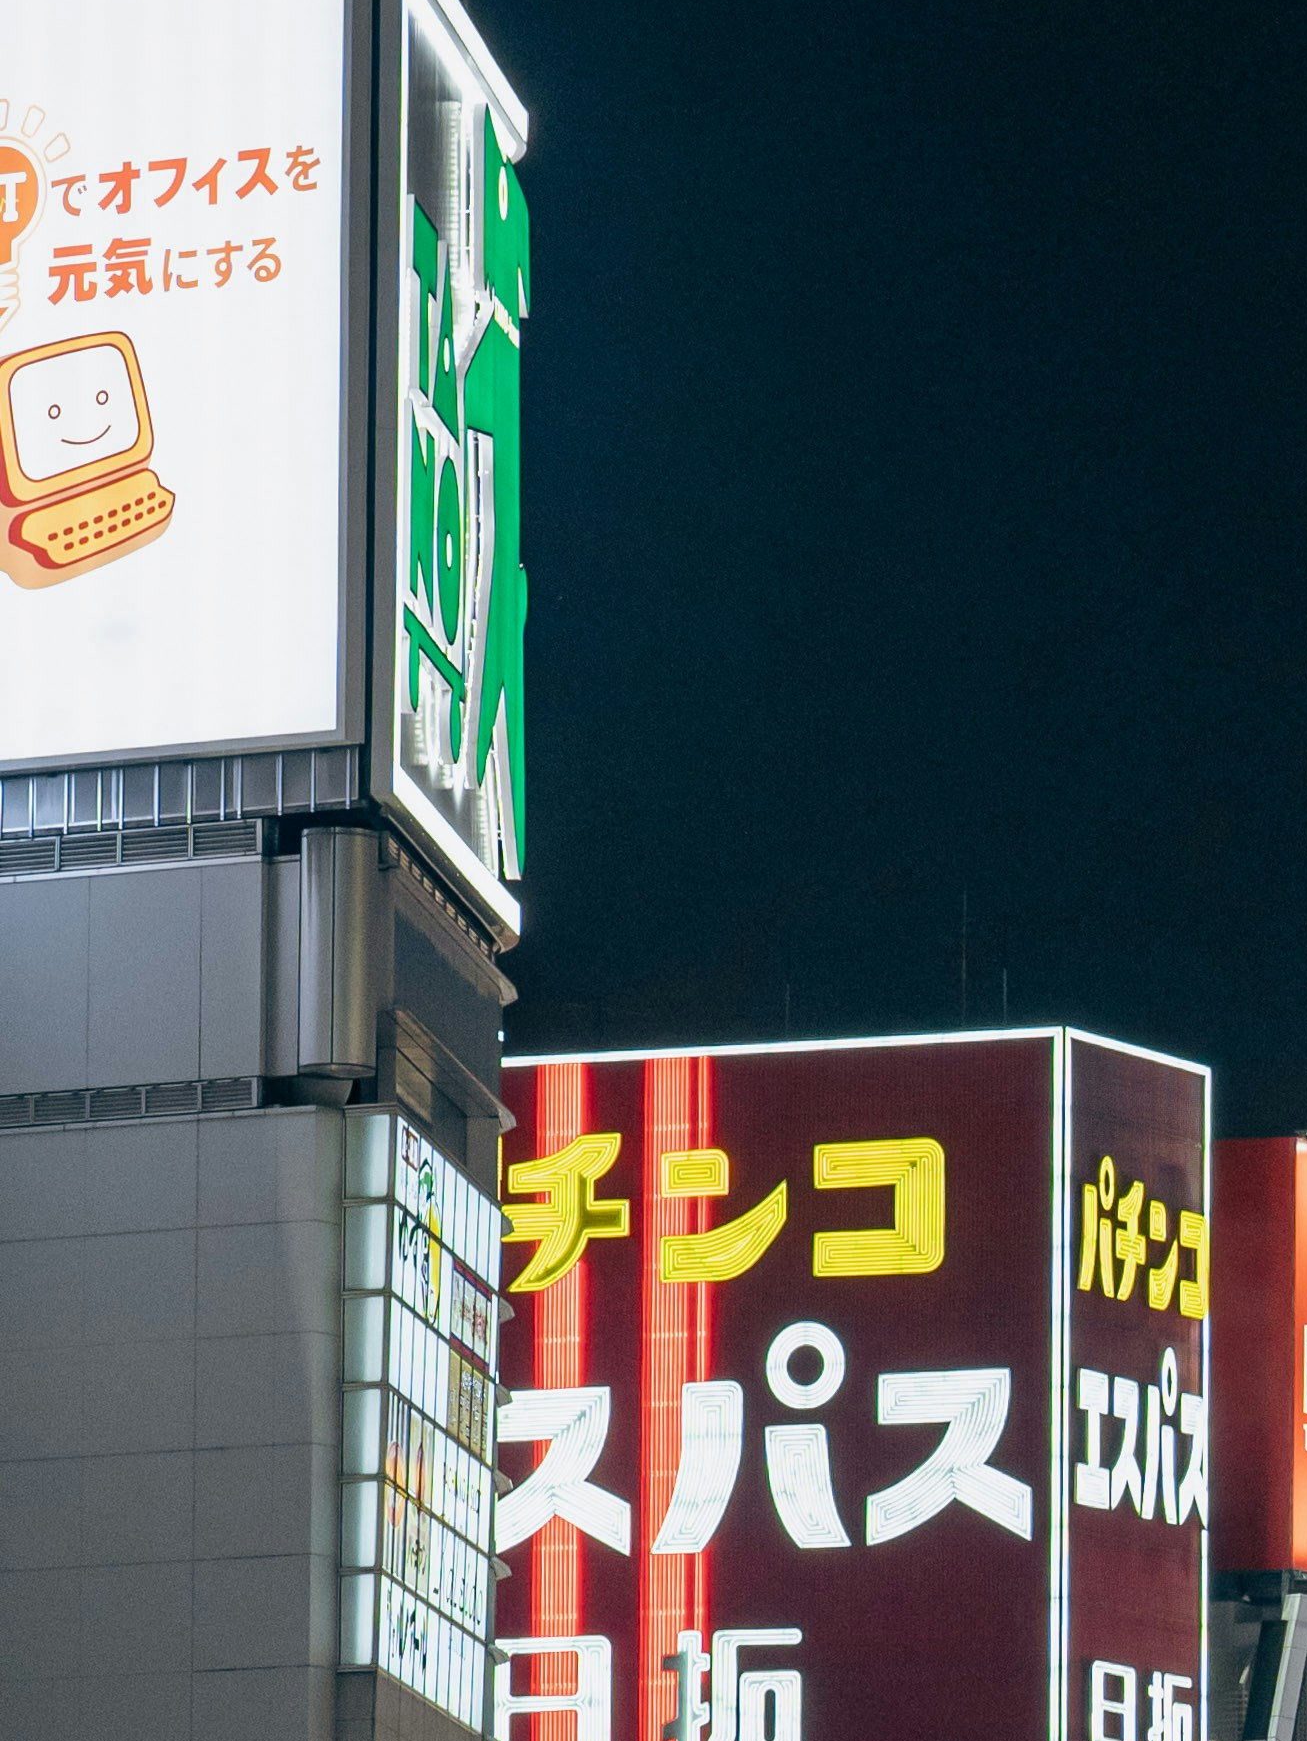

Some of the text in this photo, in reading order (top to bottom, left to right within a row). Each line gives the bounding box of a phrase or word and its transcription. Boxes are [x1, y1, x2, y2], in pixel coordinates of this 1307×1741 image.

[51, 145, 321, 217] でオフィスを
[48, 237, 282, 305] 元気にする
[1079, 1156, 1208, 1319] パチンコ
[1076, 1347, 1207, 1528] エスパス
